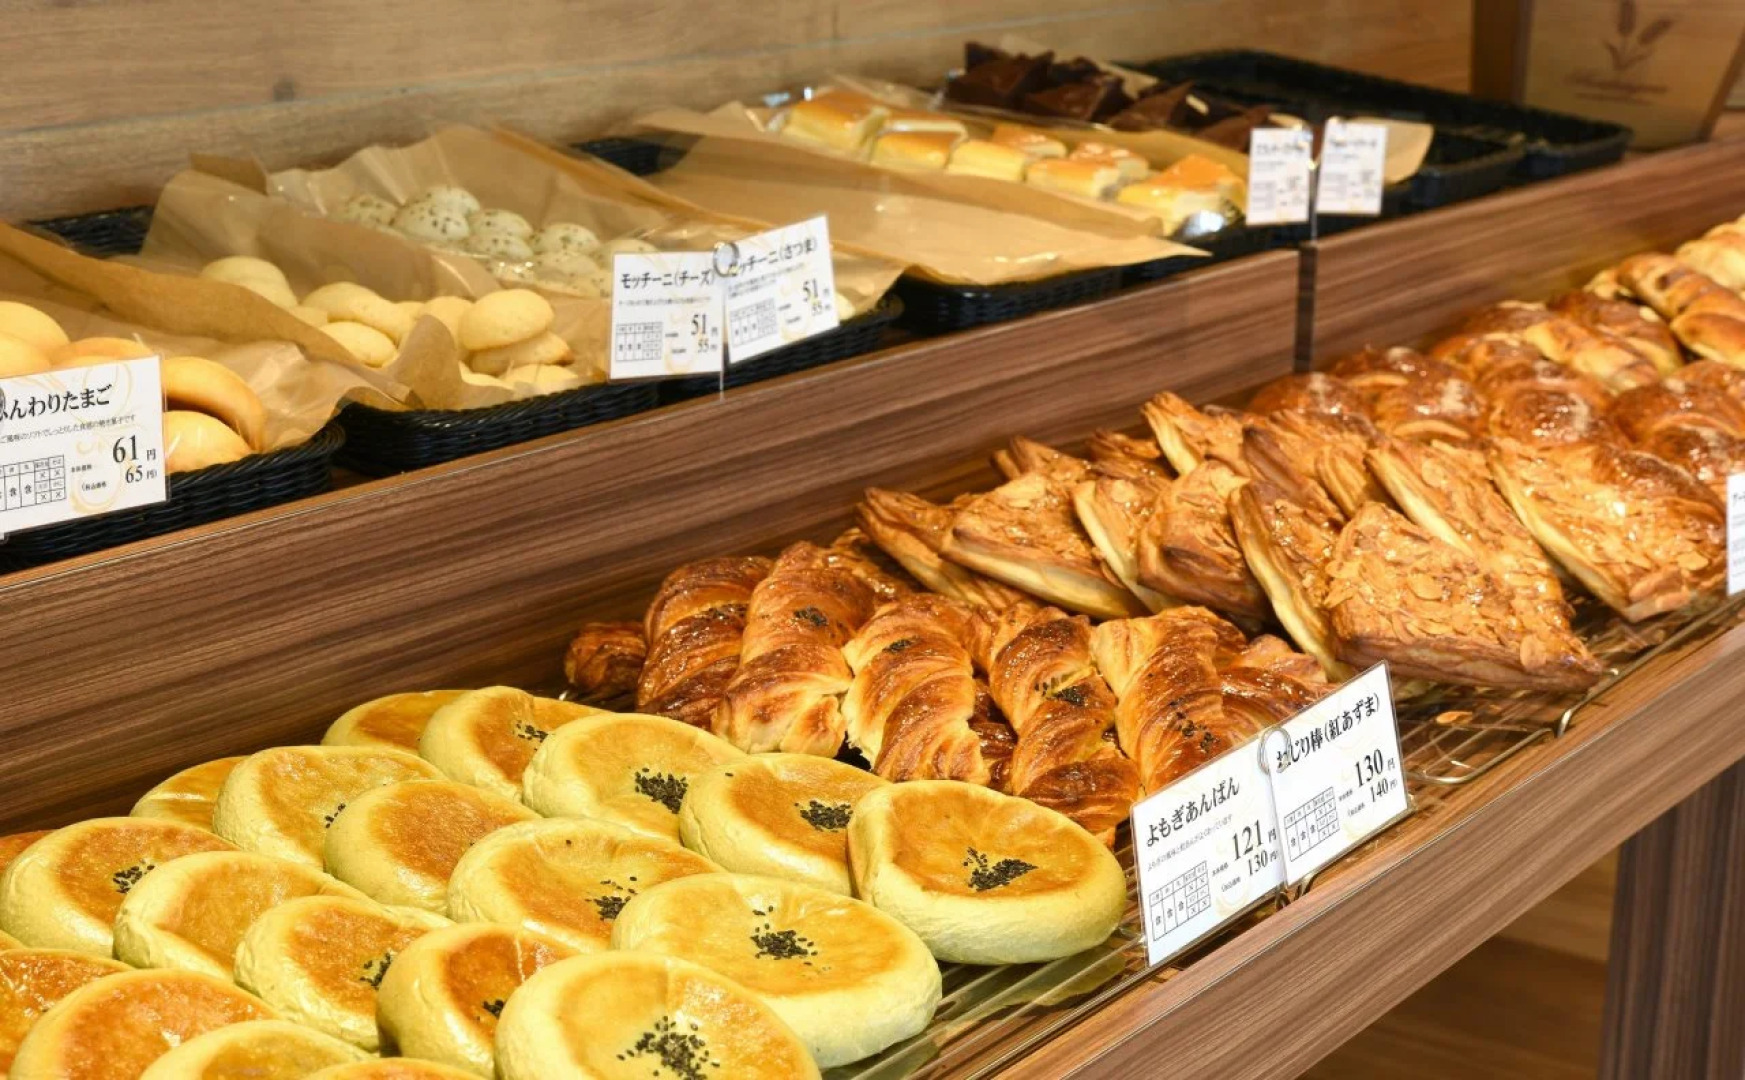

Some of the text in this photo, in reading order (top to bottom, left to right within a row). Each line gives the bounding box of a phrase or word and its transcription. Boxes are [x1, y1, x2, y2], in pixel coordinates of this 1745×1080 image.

[691, 314, 706, 335] 51
[112, 434, 139, 463] 61
[125, 464, 143, 483] 65
[1355, 748, 1384, 788] 130
[1370, 778, 1389, 803] 140
[1146, 777, 1239, 847] よもぎあんぱん
[1232, 819, 1264, 861] 121
[1248, 850, 1268, 876] 130
